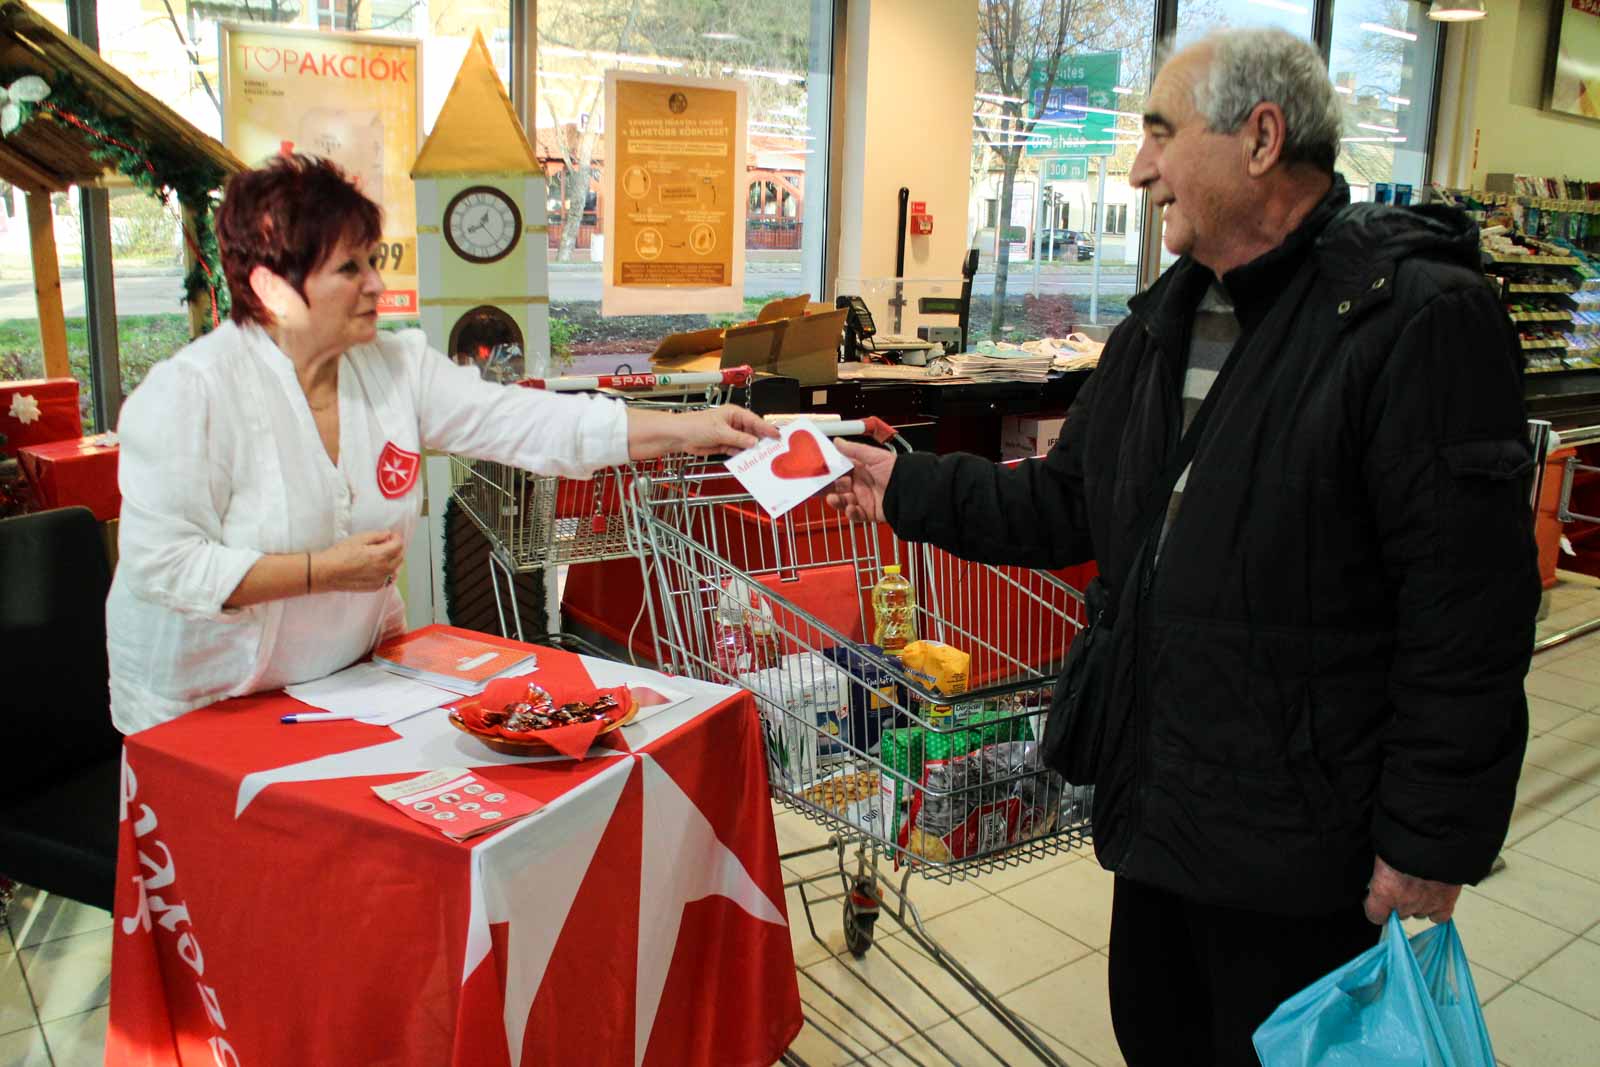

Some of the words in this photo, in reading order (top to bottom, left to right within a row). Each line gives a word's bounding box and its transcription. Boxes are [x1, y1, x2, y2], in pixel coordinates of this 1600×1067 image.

[1049, 163, 1067, 175] 300
[1071, 165, 1081, 175] m
[611, 376, 656, 387] SPAR
